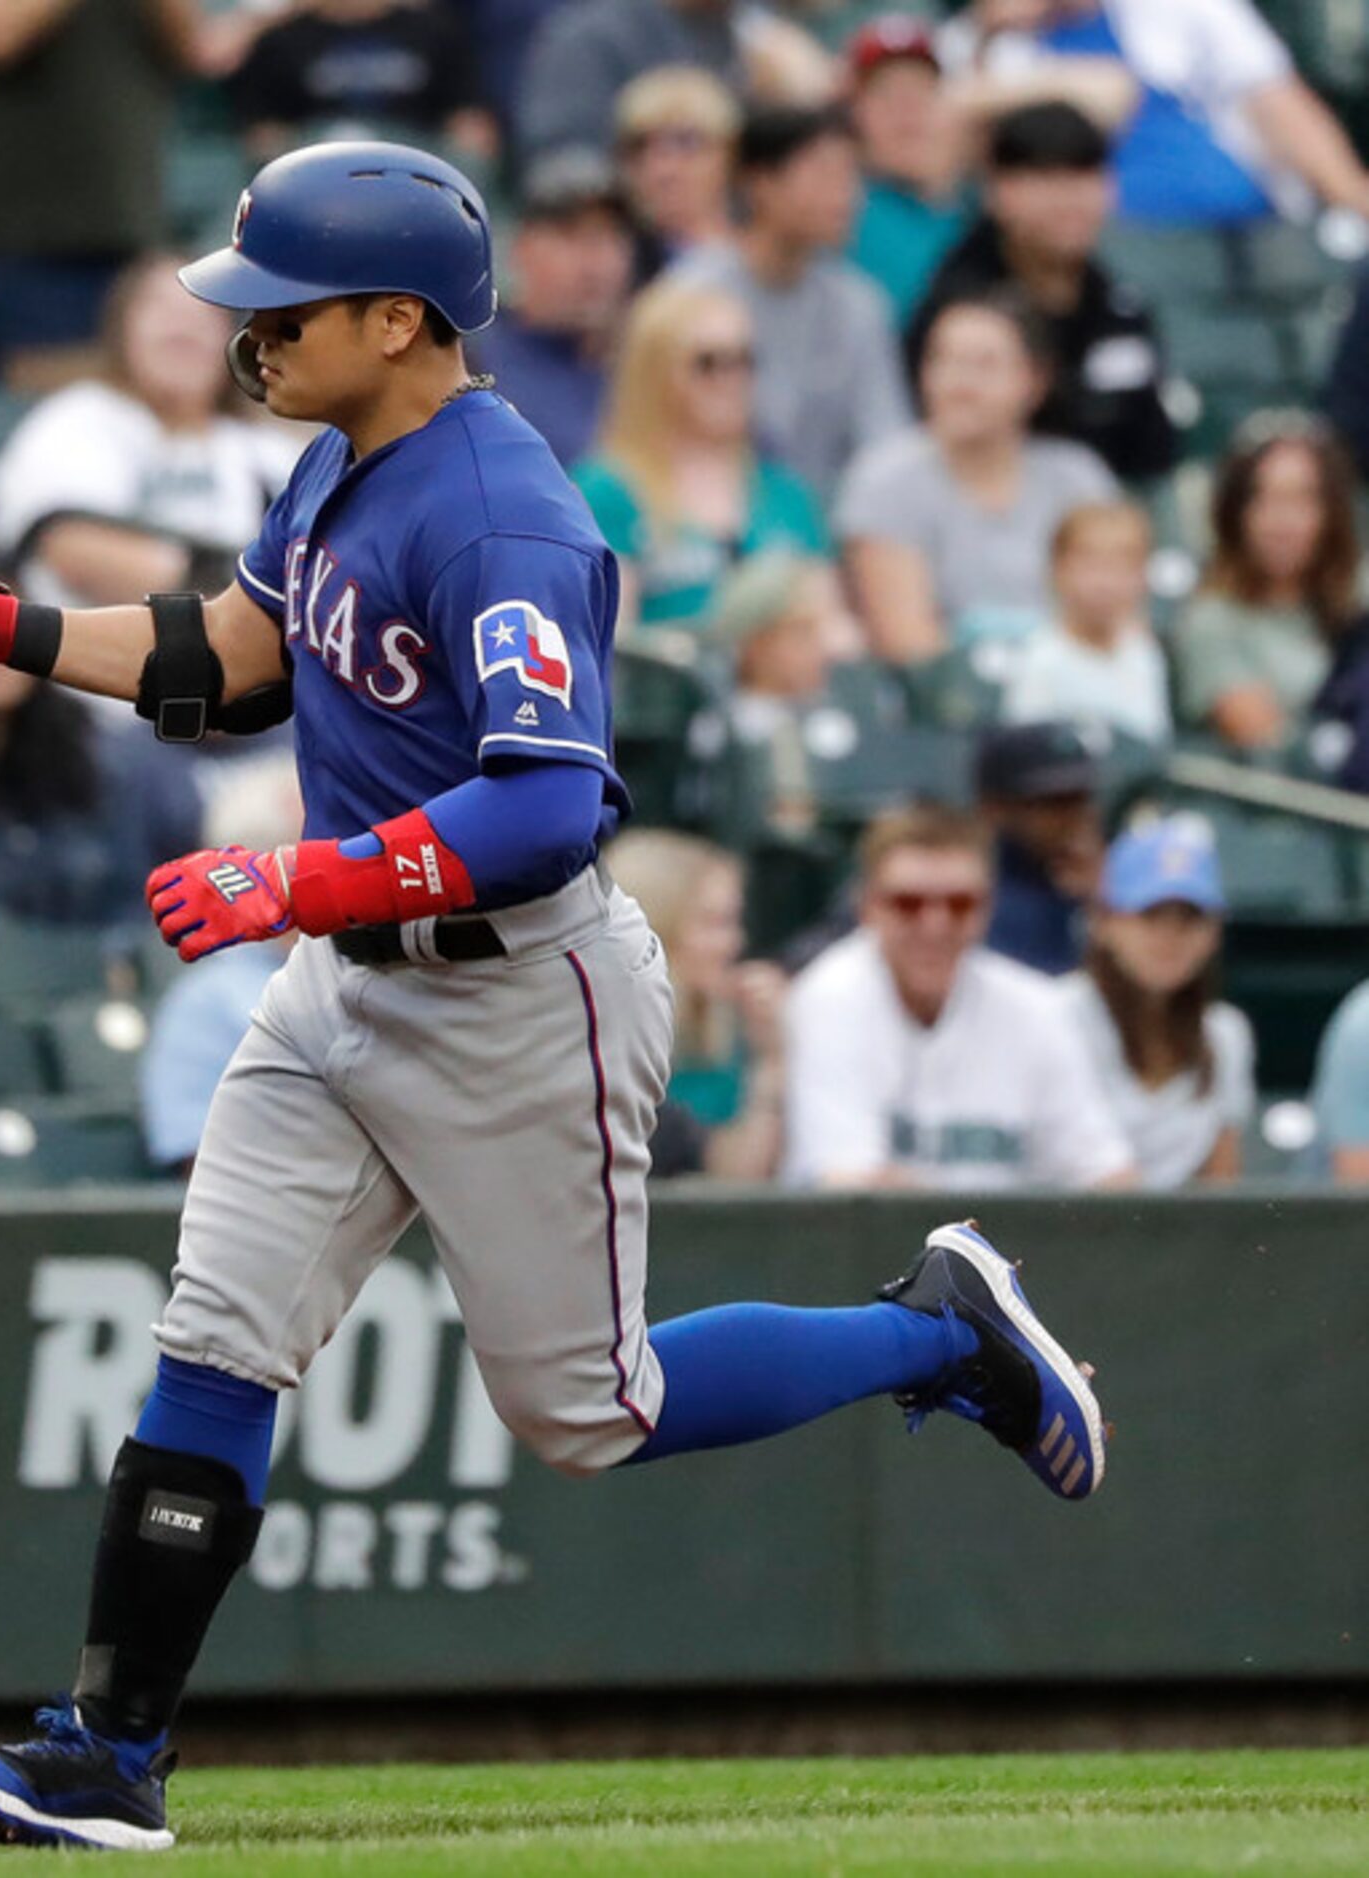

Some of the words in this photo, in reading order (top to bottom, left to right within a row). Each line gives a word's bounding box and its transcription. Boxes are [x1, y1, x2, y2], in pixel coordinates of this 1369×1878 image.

[284, 541, 427, 706] EXAS
[395, 853, 422, 889] 17
[18, 1255, 512, 1490] ROT
[247, 1500, 504, 1591] ORTS
